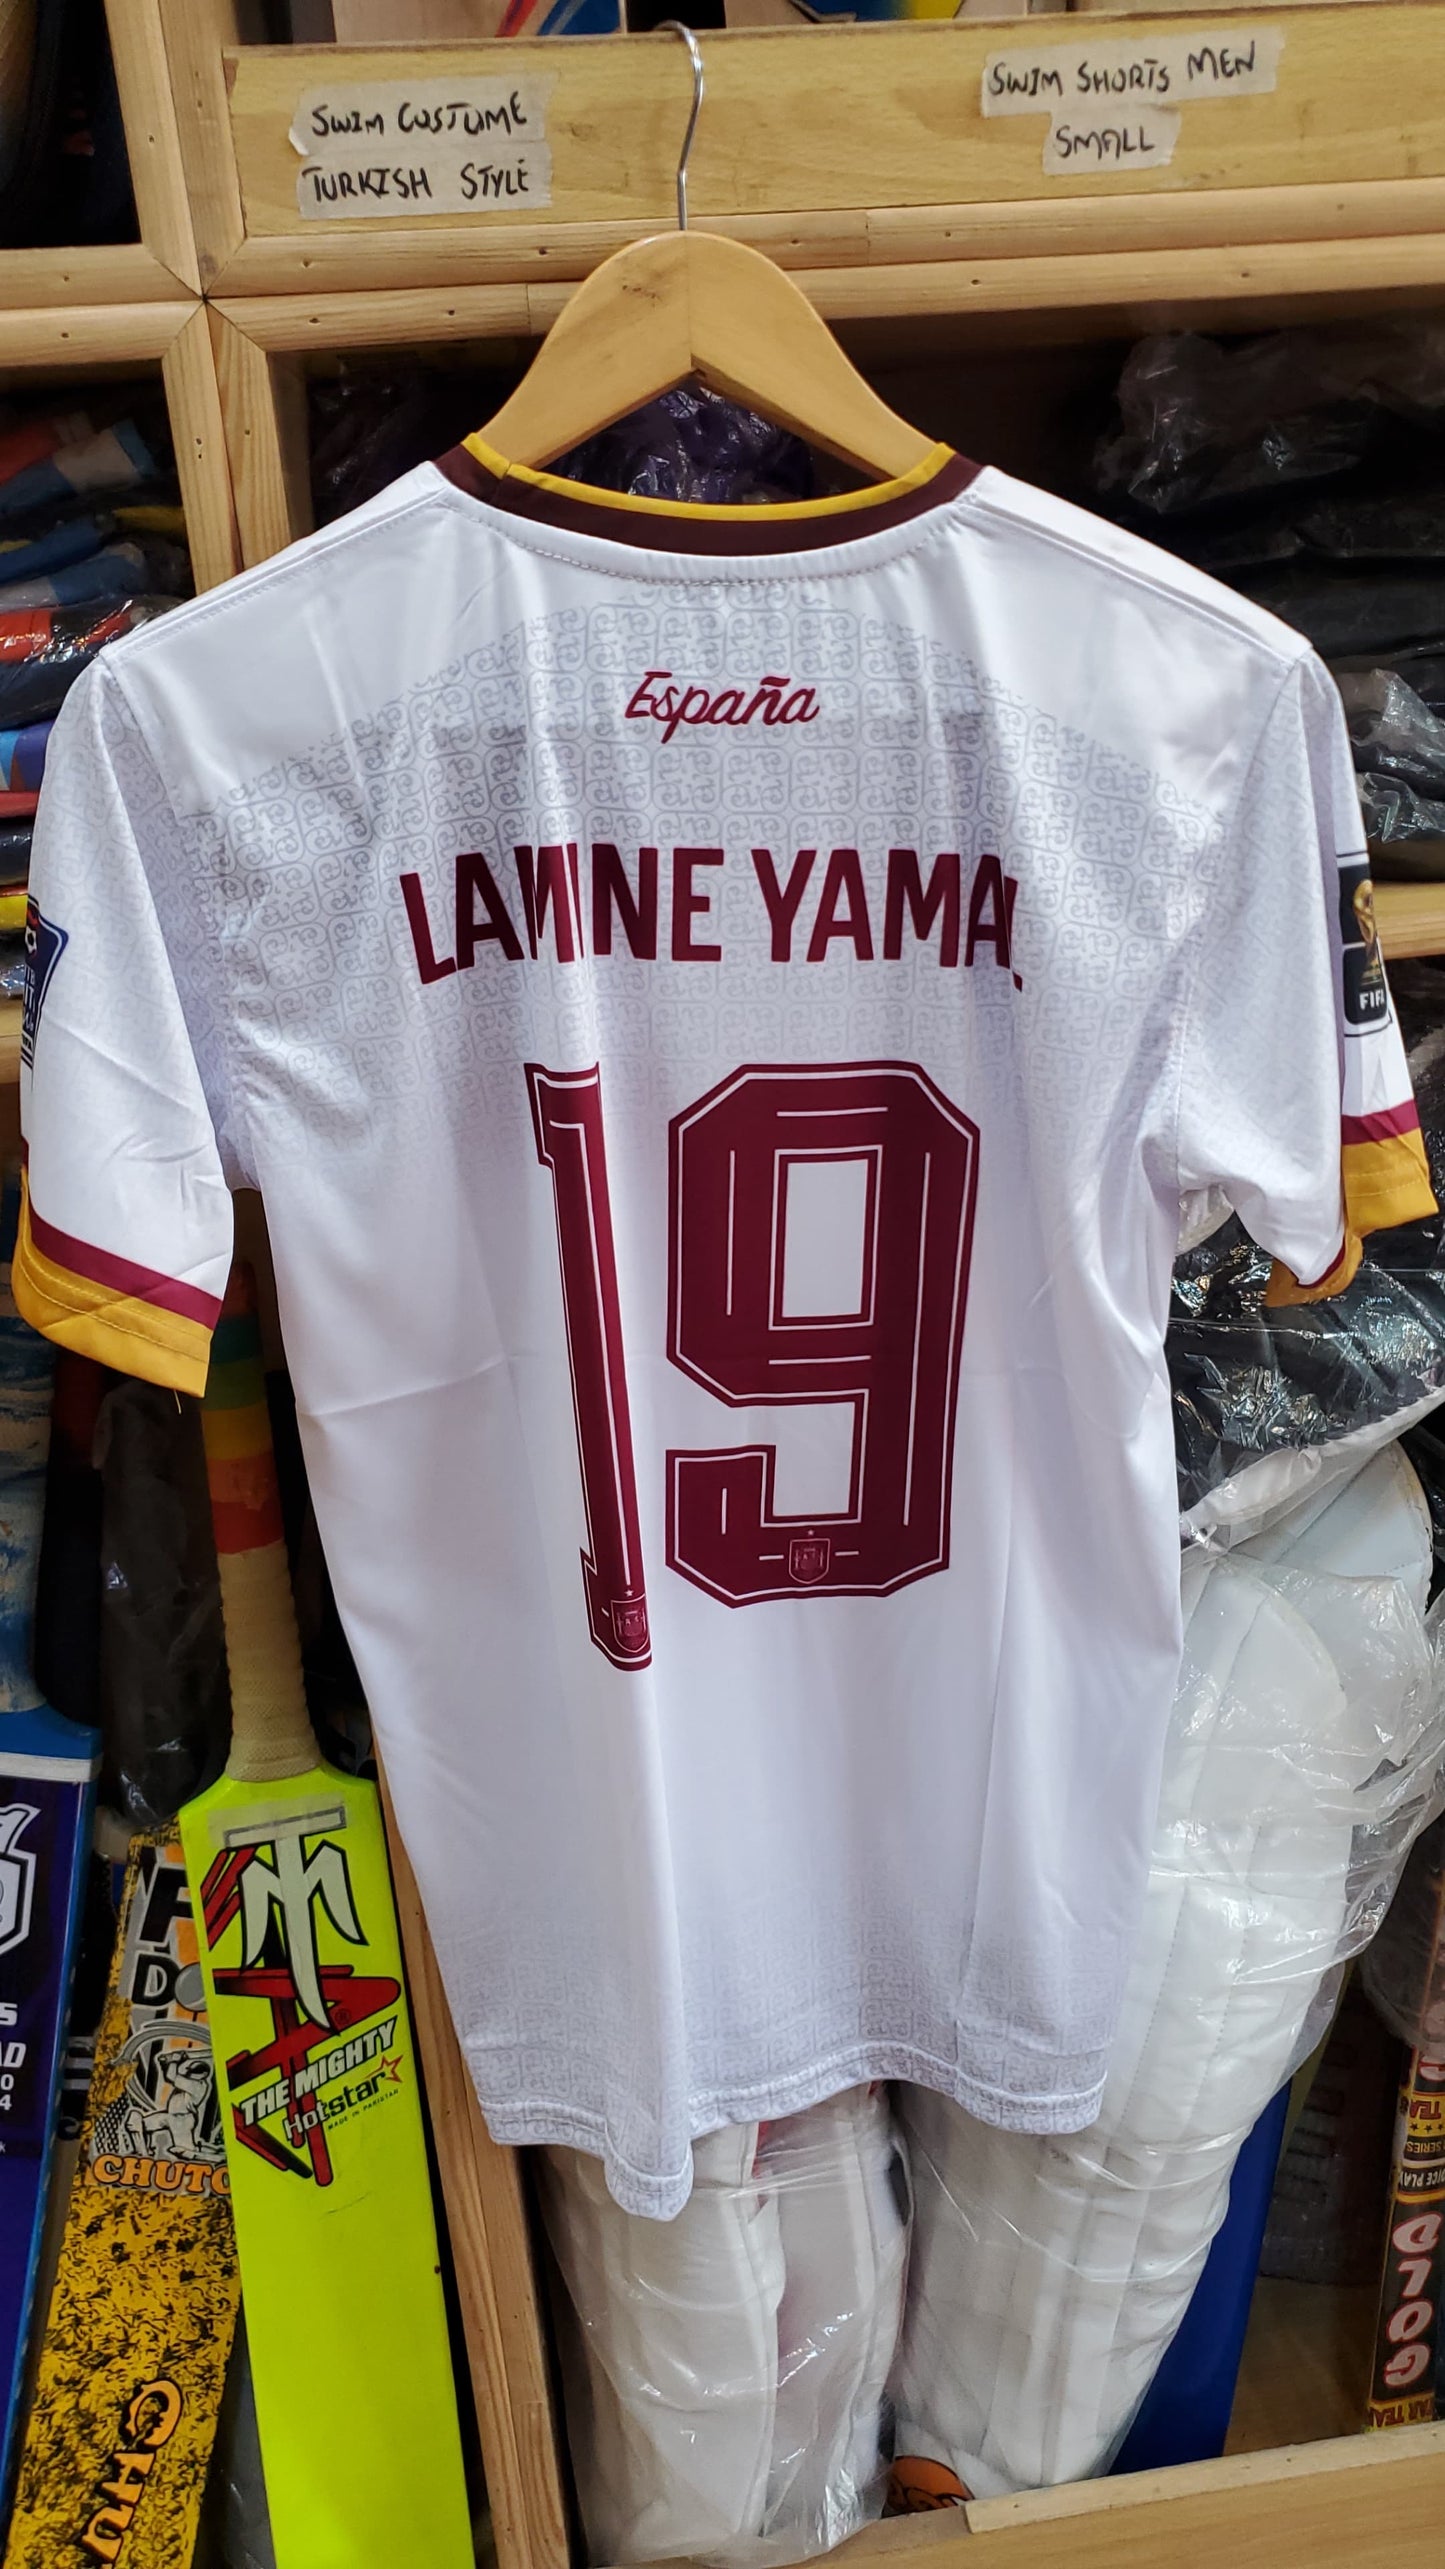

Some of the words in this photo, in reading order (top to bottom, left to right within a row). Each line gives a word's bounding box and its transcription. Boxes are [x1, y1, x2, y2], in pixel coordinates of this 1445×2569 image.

[986, 62, 1063, 97] SWIM
[1077, 59, 1170, 93] SHORTS
[1186, 40, 1256, 81] MEN
[311, 103, 385, 137] SWIM
[1055, 125, 1156, 160] SMALL
[301, 165, 433, 202] TURKISH
[460, 158, 530, 200] STYLE
[624, 671, 821, 744] España
[523, 1060, 981, 1671] 19
[239, 2078, 291, 2127] THE
[294, 2015, 398, 2100] MIGHTY
[282, 2069, 386, 2142] Hotstar
[327, 2115, 349, 2131] MADE
[352, 2109, 361, 2118] IN
[77, 2377, 184, 2569] CHU
